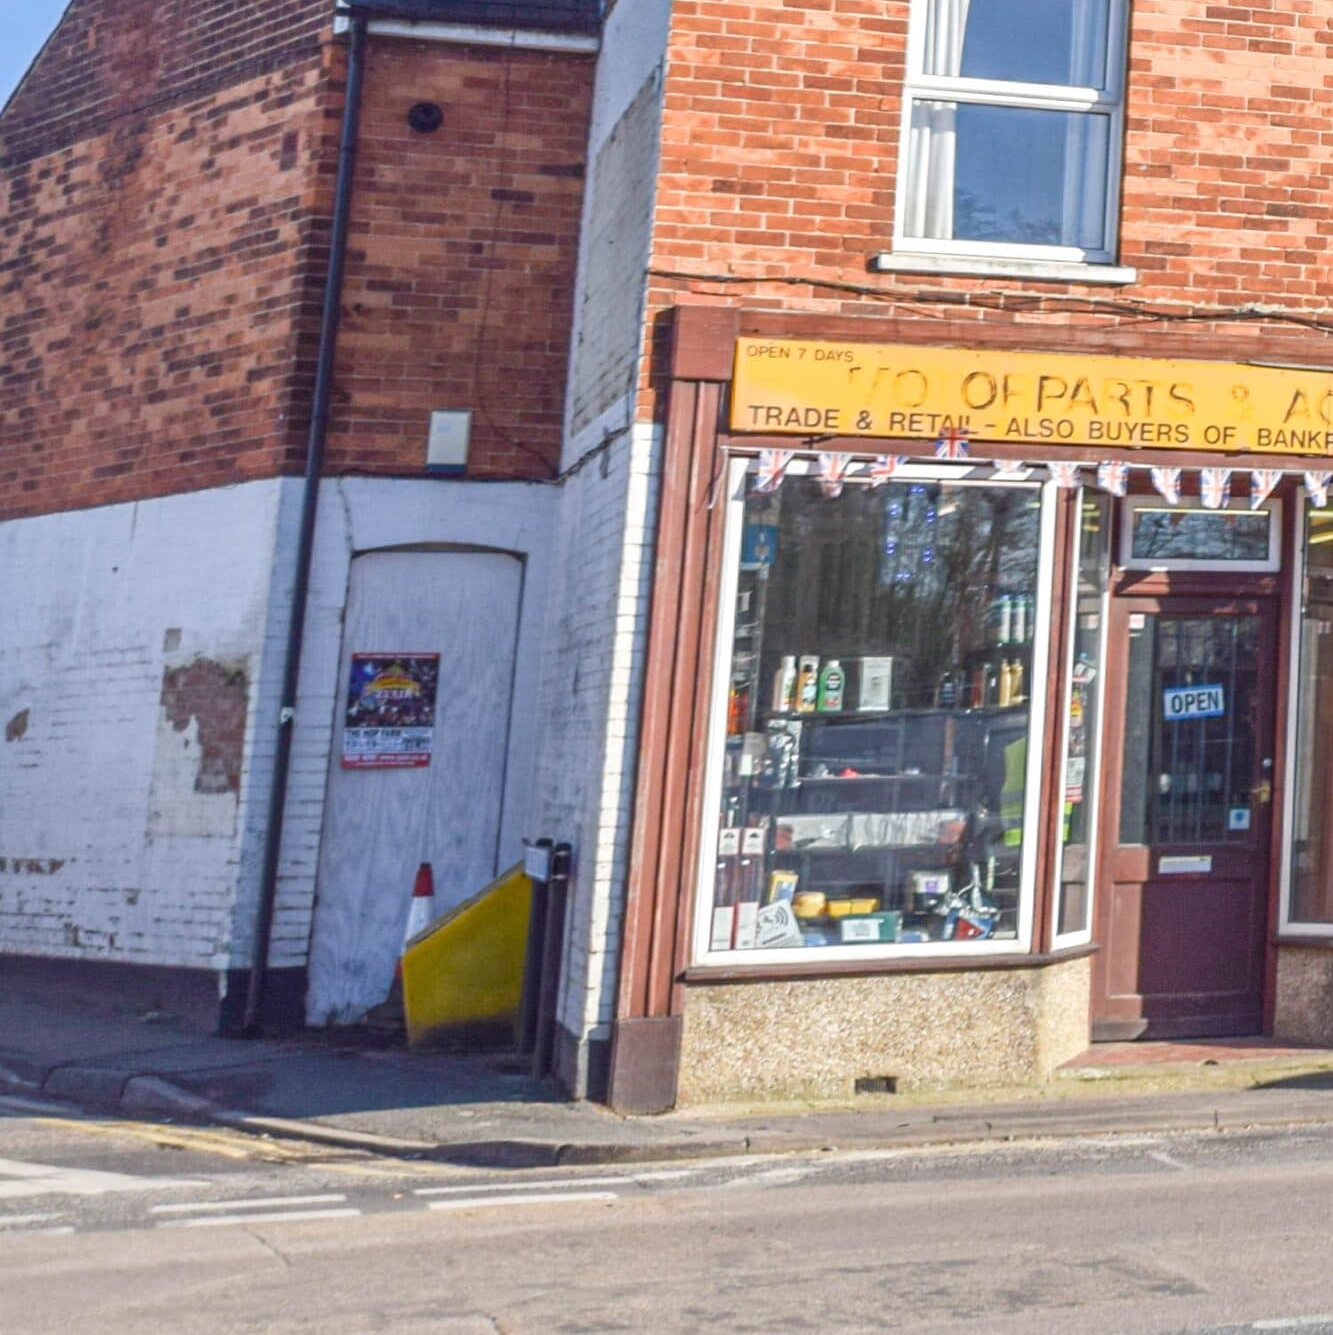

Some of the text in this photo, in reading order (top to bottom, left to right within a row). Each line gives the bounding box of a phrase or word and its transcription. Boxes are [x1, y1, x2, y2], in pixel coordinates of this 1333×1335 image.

[747, 345, 854, 362] OPEN 7 DAYS
[748, 405, 841, 429] TRADE
[856, 410, 873, 431] &
[1005, 417, 1074, 439] ALSO
[1089, 421, 1189, 444] BUYERS
[1203, 425, 1237, 445] OF
[1171, 690, 1219, 713] OPEN
